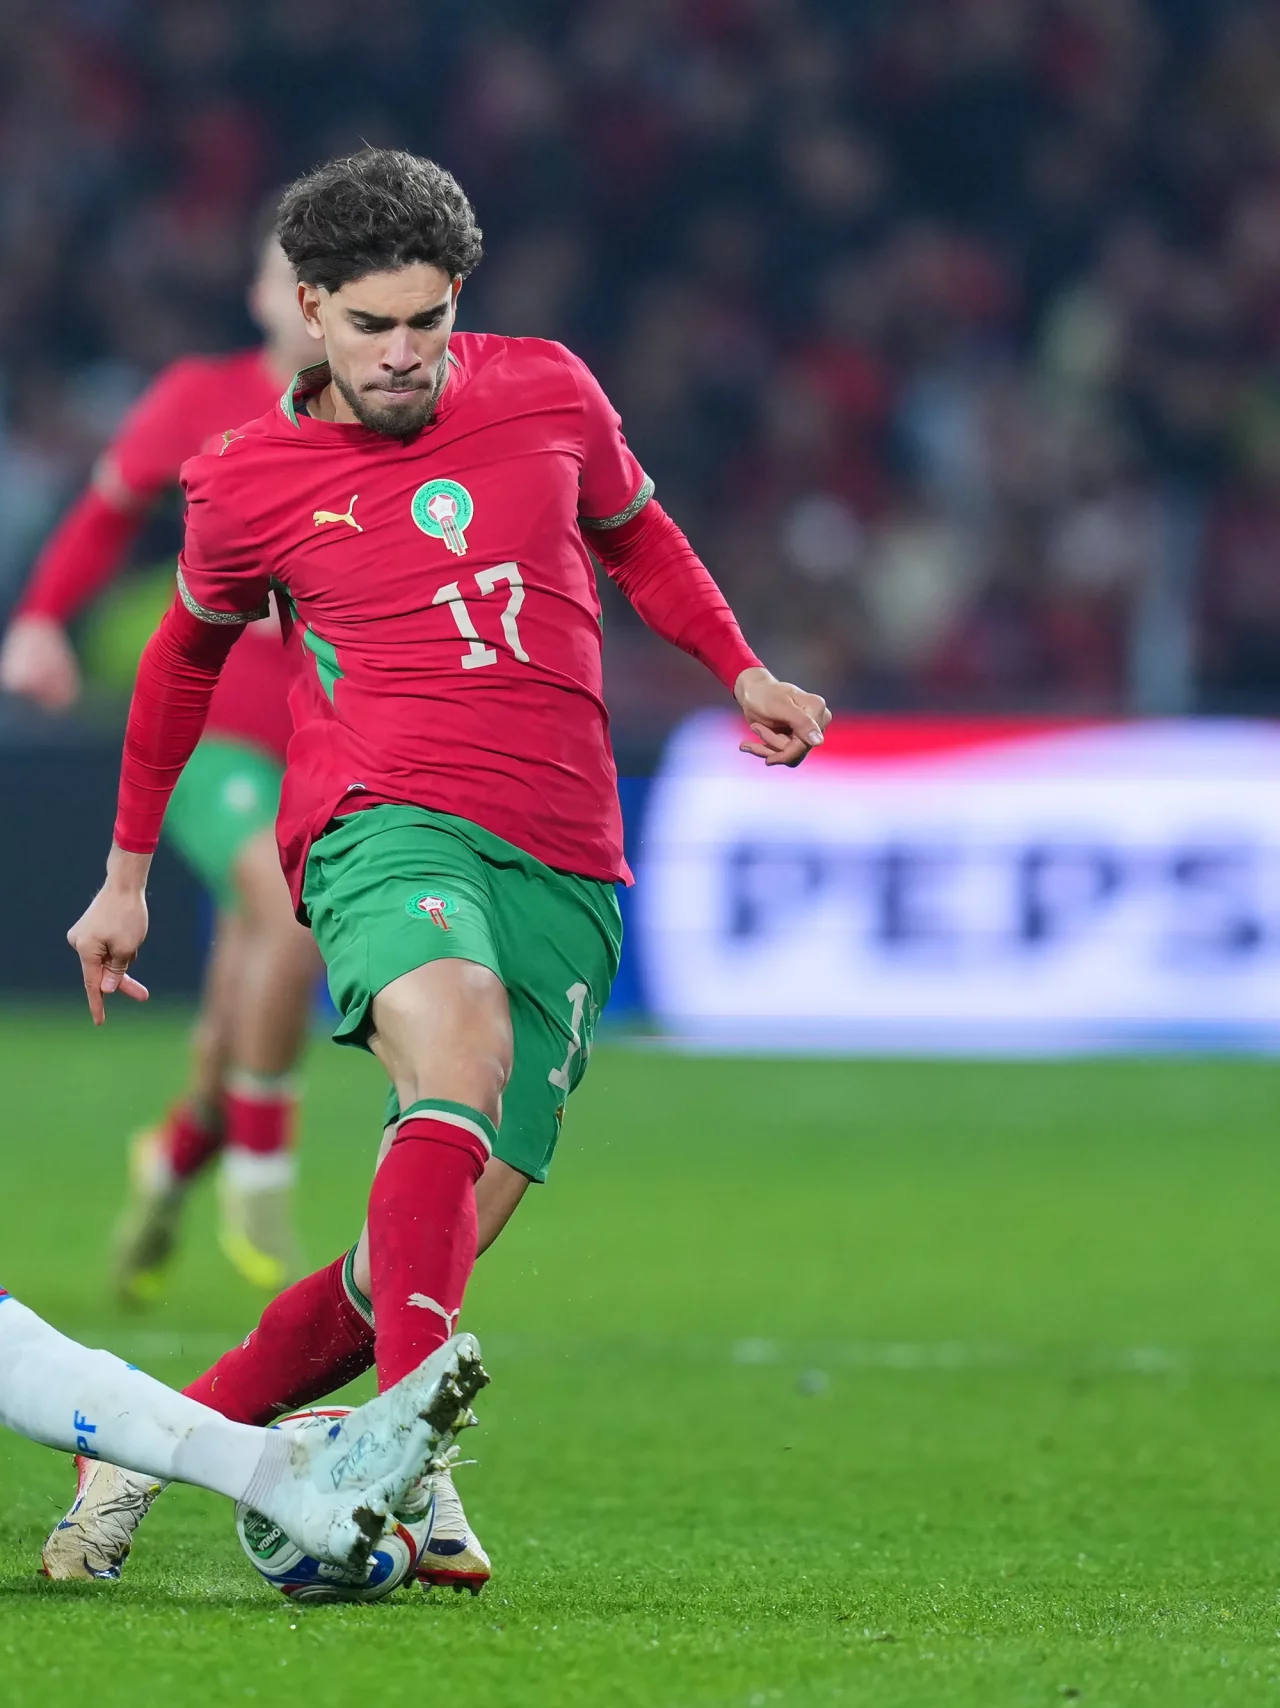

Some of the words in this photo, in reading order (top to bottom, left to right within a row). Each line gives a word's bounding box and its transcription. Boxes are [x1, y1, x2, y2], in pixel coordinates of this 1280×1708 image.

[431, 560, 530, 670] 17
[723, 832, 1280, 964] PEPS
[548, 982, 598, 1090] 1
[73, 1409, 99, 1457] PF
[257, 1527, 284, 1551] ONDA
